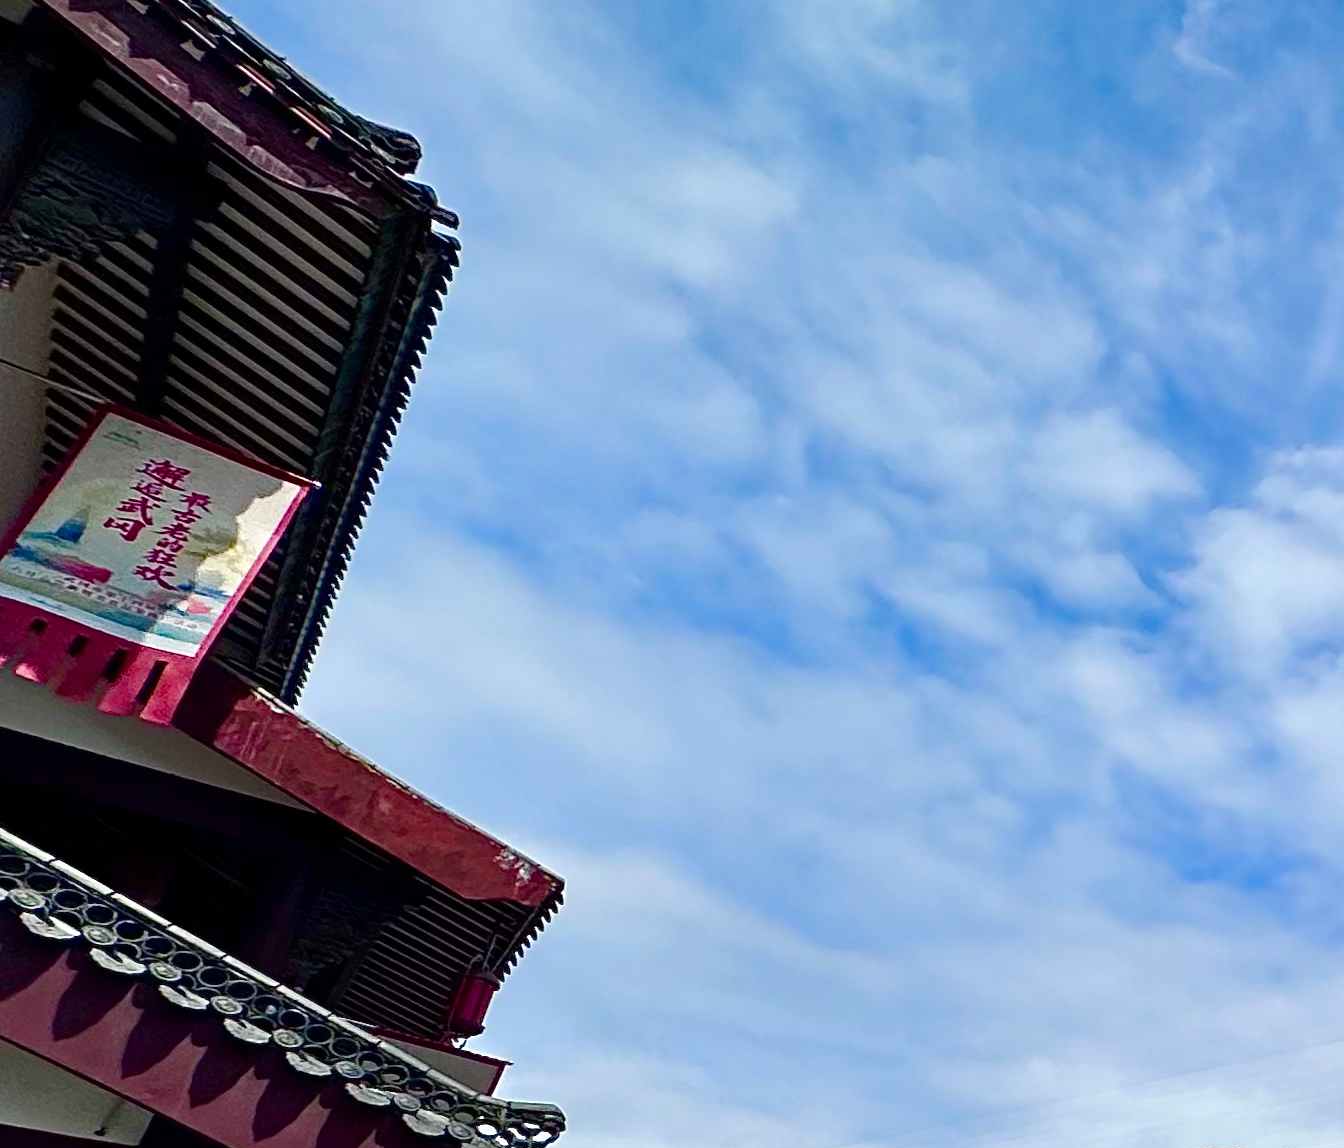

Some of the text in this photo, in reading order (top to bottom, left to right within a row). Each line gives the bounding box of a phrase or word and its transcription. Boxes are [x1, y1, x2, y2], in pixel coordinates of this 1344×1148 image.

[133, 491, 212, 592] 最古老的狂欢
